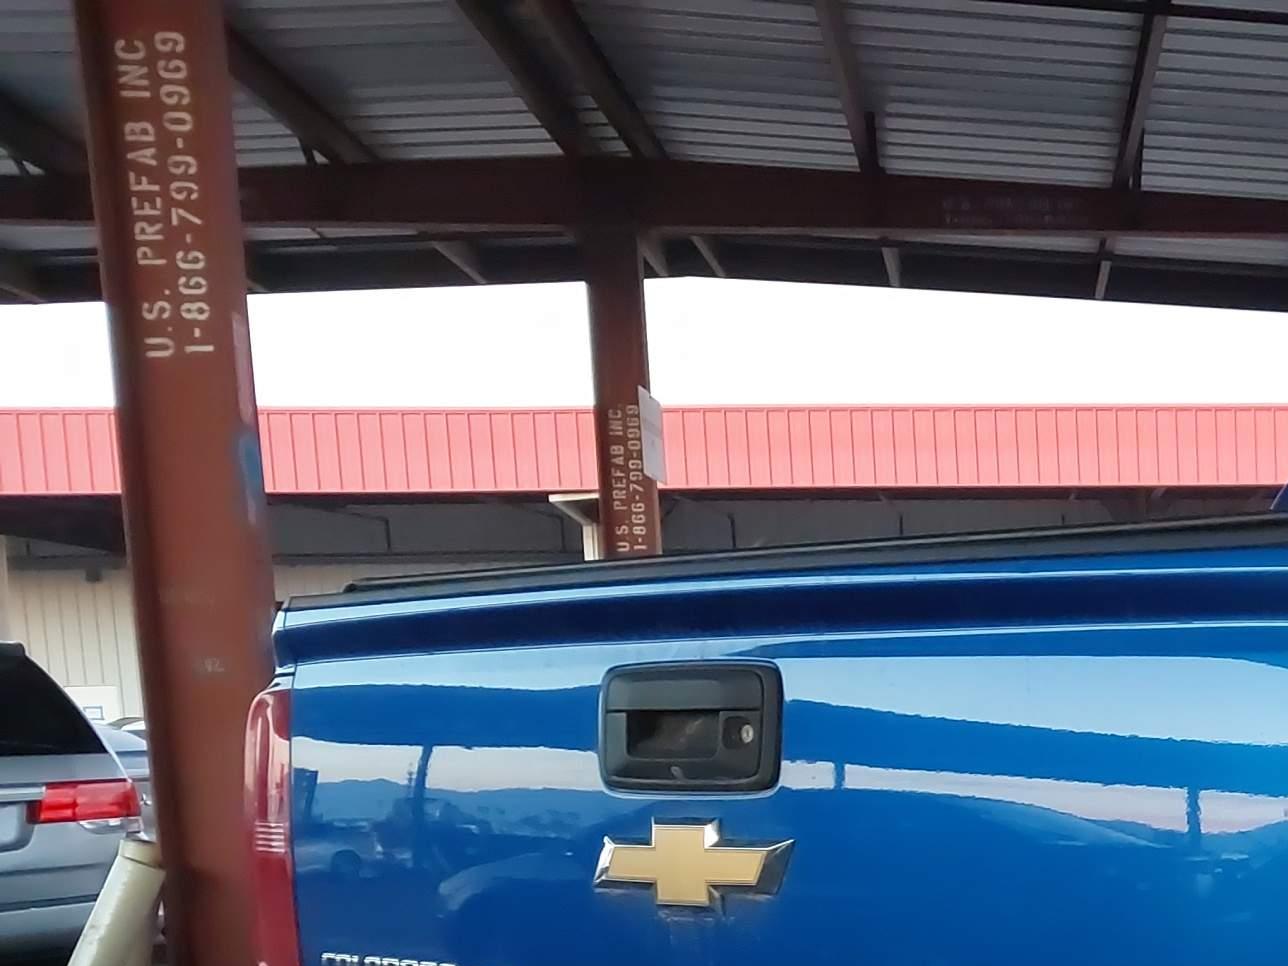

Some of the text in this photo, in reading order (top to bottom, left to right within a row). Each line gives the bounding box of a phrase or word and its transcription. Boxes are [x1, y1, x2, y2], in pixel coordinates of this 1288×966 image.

[114, 39, 176, 358] U.S. PREFAB INC
[154, 30, 215, 355] 1-866-799-0969
[610, 444, 628, 511] PREFAB
[615, 520, 630, 552] U.S.
[626, 404, 648, 550] 1-866-799-0969
